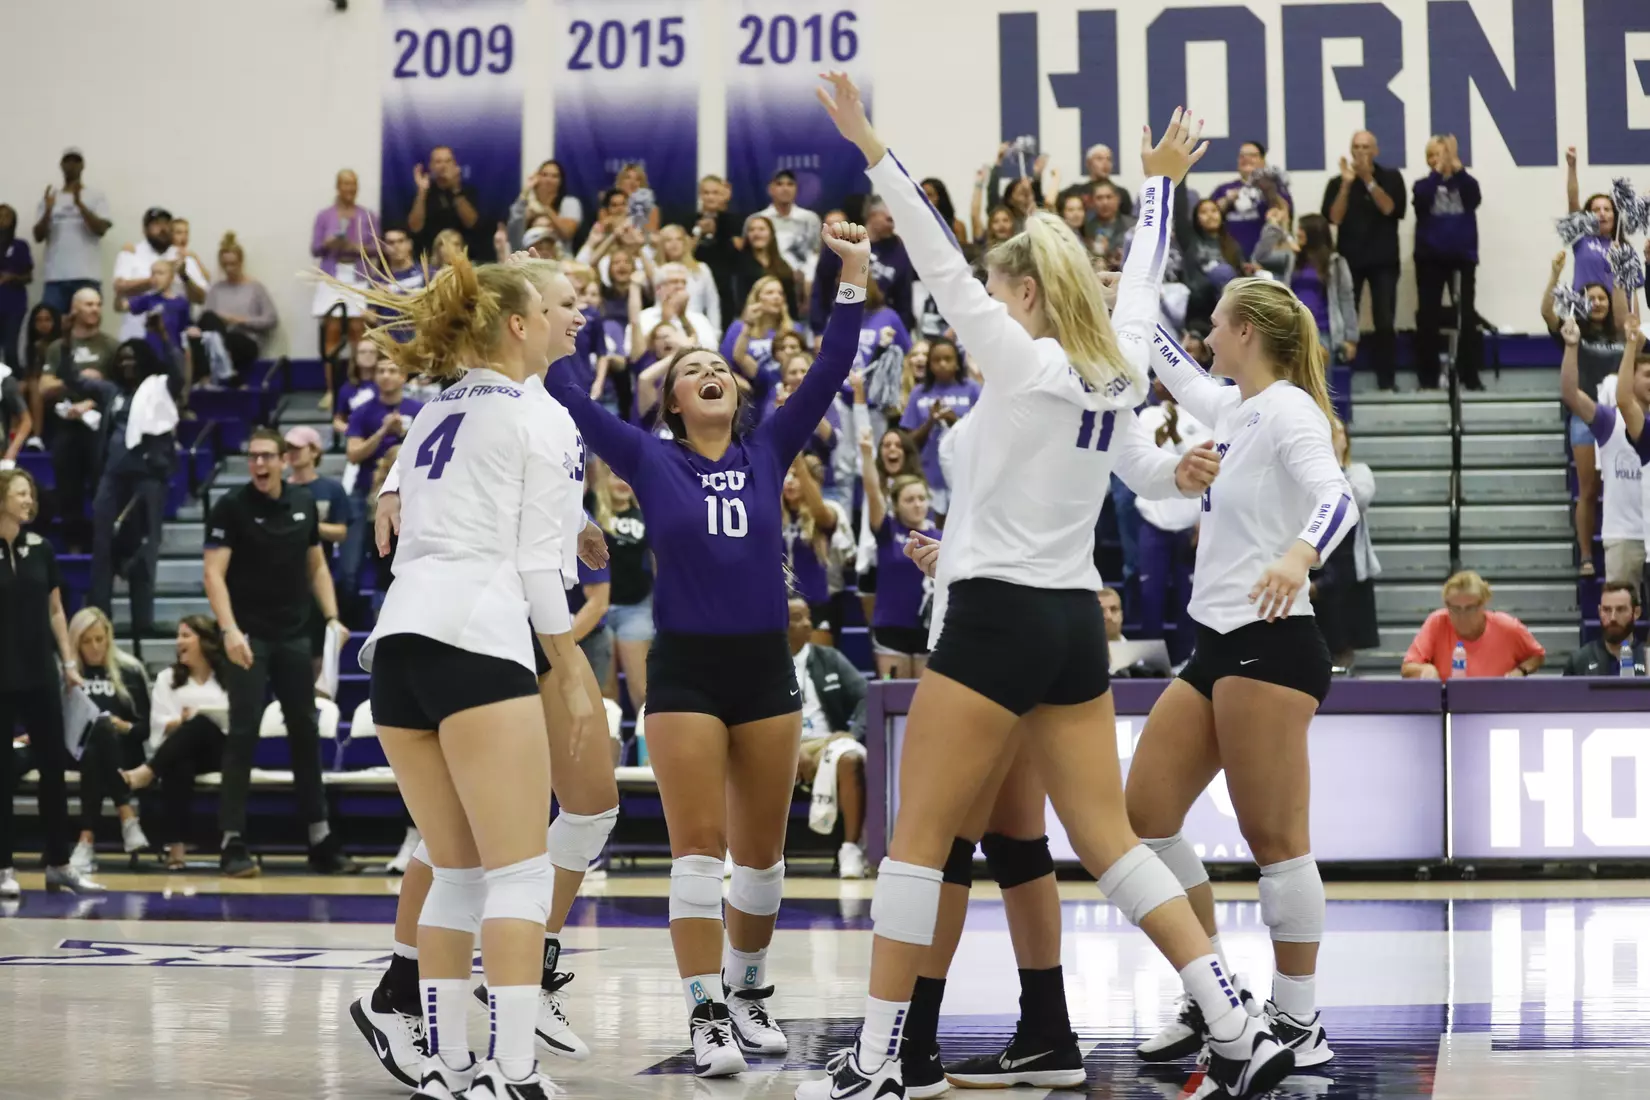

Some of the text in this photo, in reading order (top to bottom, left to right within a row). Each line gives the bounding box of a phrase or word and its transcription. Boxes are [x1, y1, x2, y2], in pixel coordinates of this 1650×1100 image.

[393, 24, 515, 79] 2009
[567, 16, 686, 70] 2015
[738, 10, 859, 65] 2016
[1160, 346, 1181, 367] RAM
[468, 384, 524, 398] FROGS
[414, 411, 467, 480] 4
[1076, 409, 1117, 452] 11
[704, 495, 748, 537] 10
